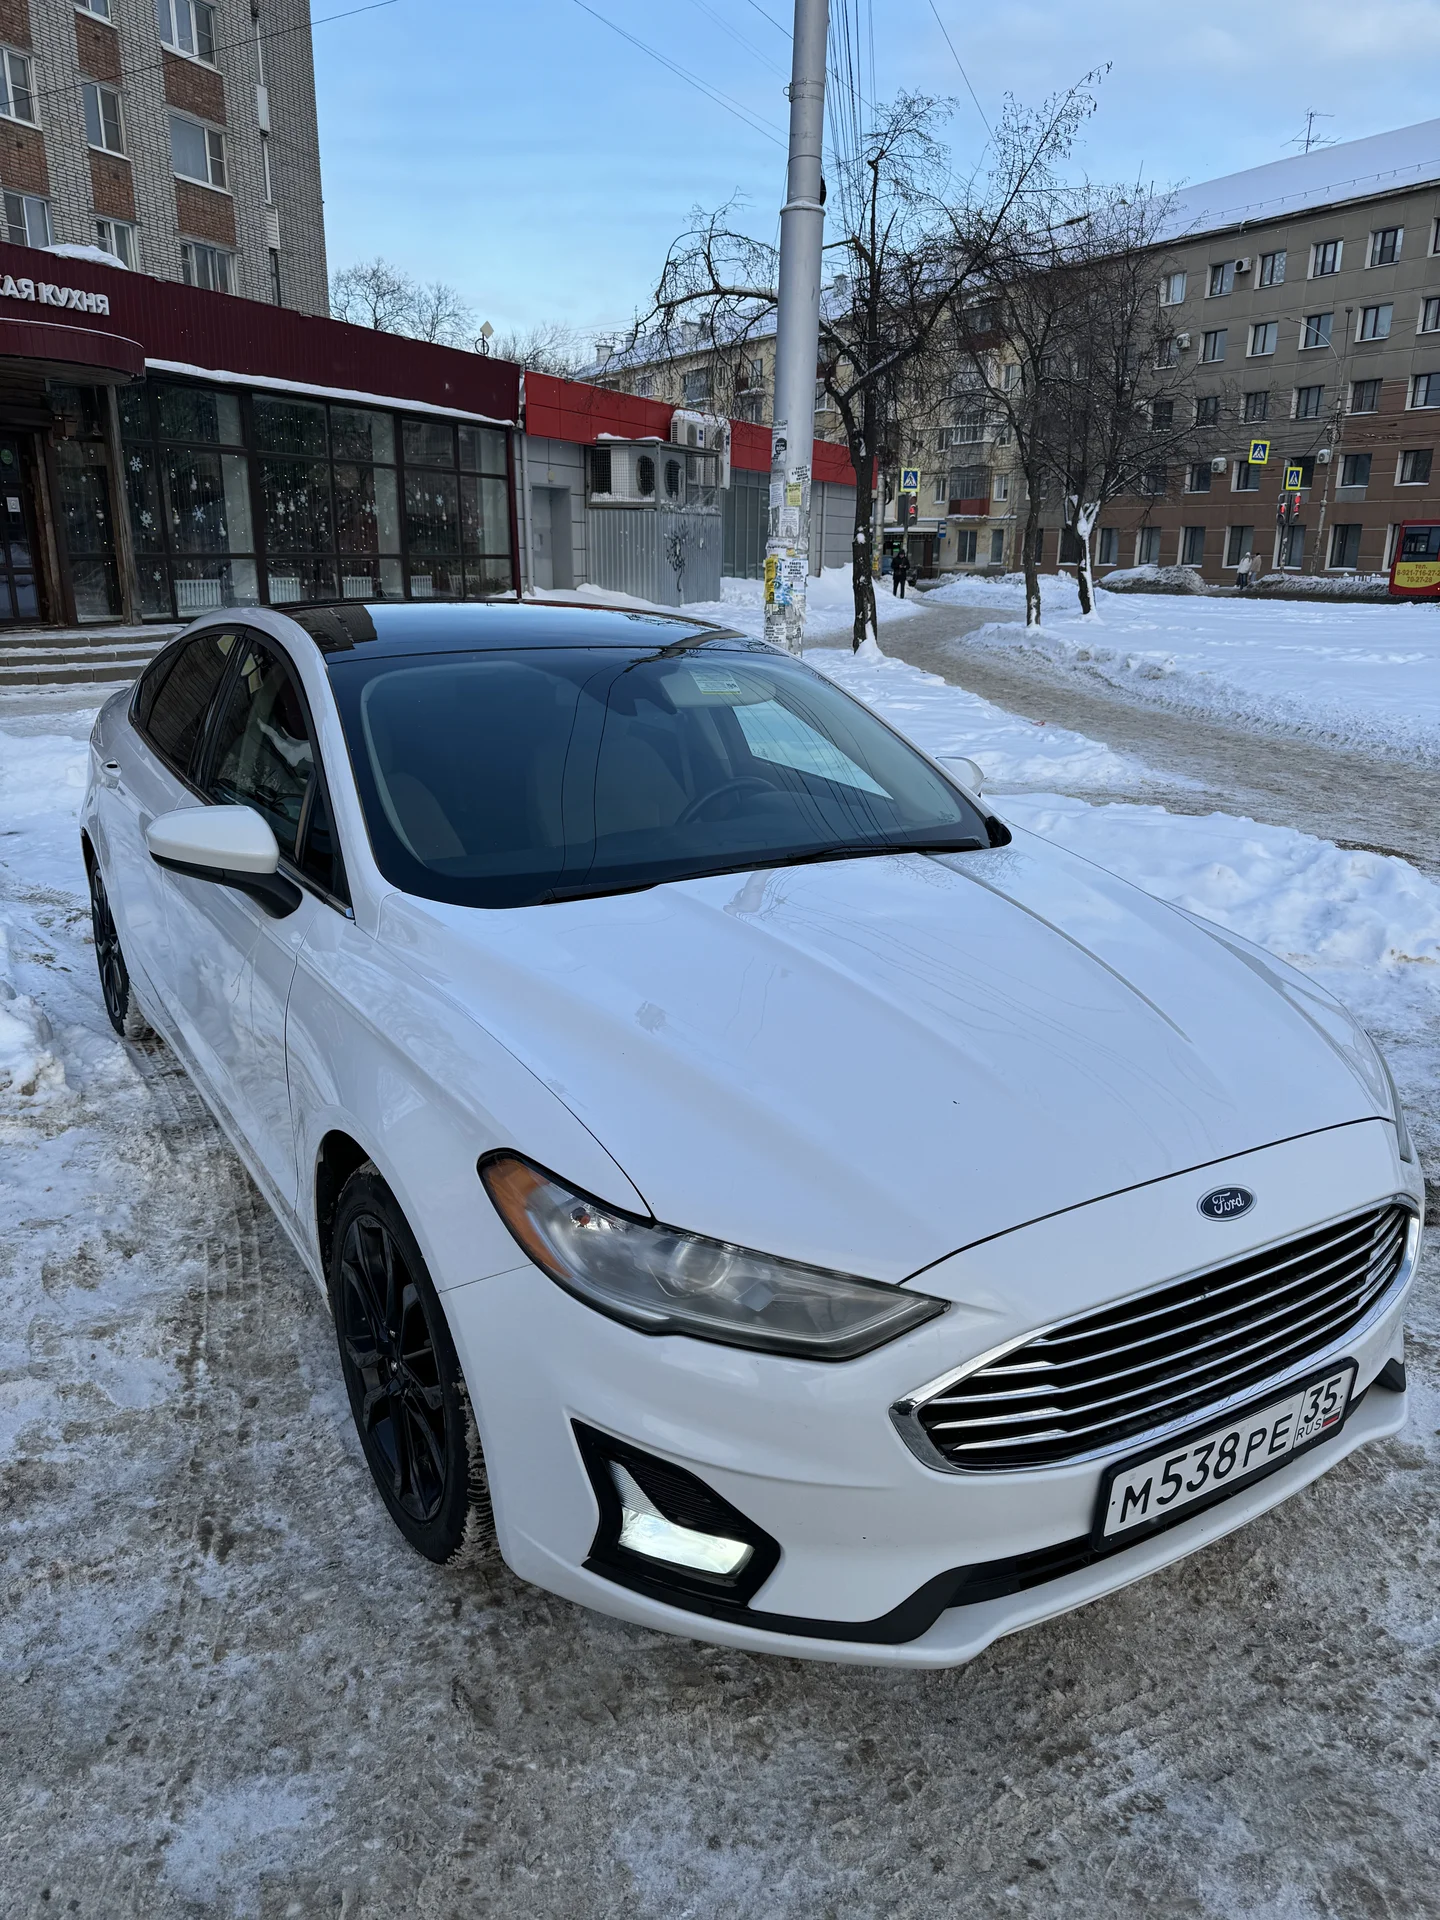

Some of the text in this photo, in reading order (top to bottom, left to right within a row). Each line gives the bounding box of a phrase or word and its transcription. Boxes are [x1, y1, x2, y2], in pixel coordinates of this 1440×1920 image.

[0, 275, 110, 316] АЯ КУХНЯ
[1212, 1192, 1245, 1214] Ford
[1296, 1418, 1322, 1441] RUS
[1119, 1377, 1342, 1523] М538РЕ 35
